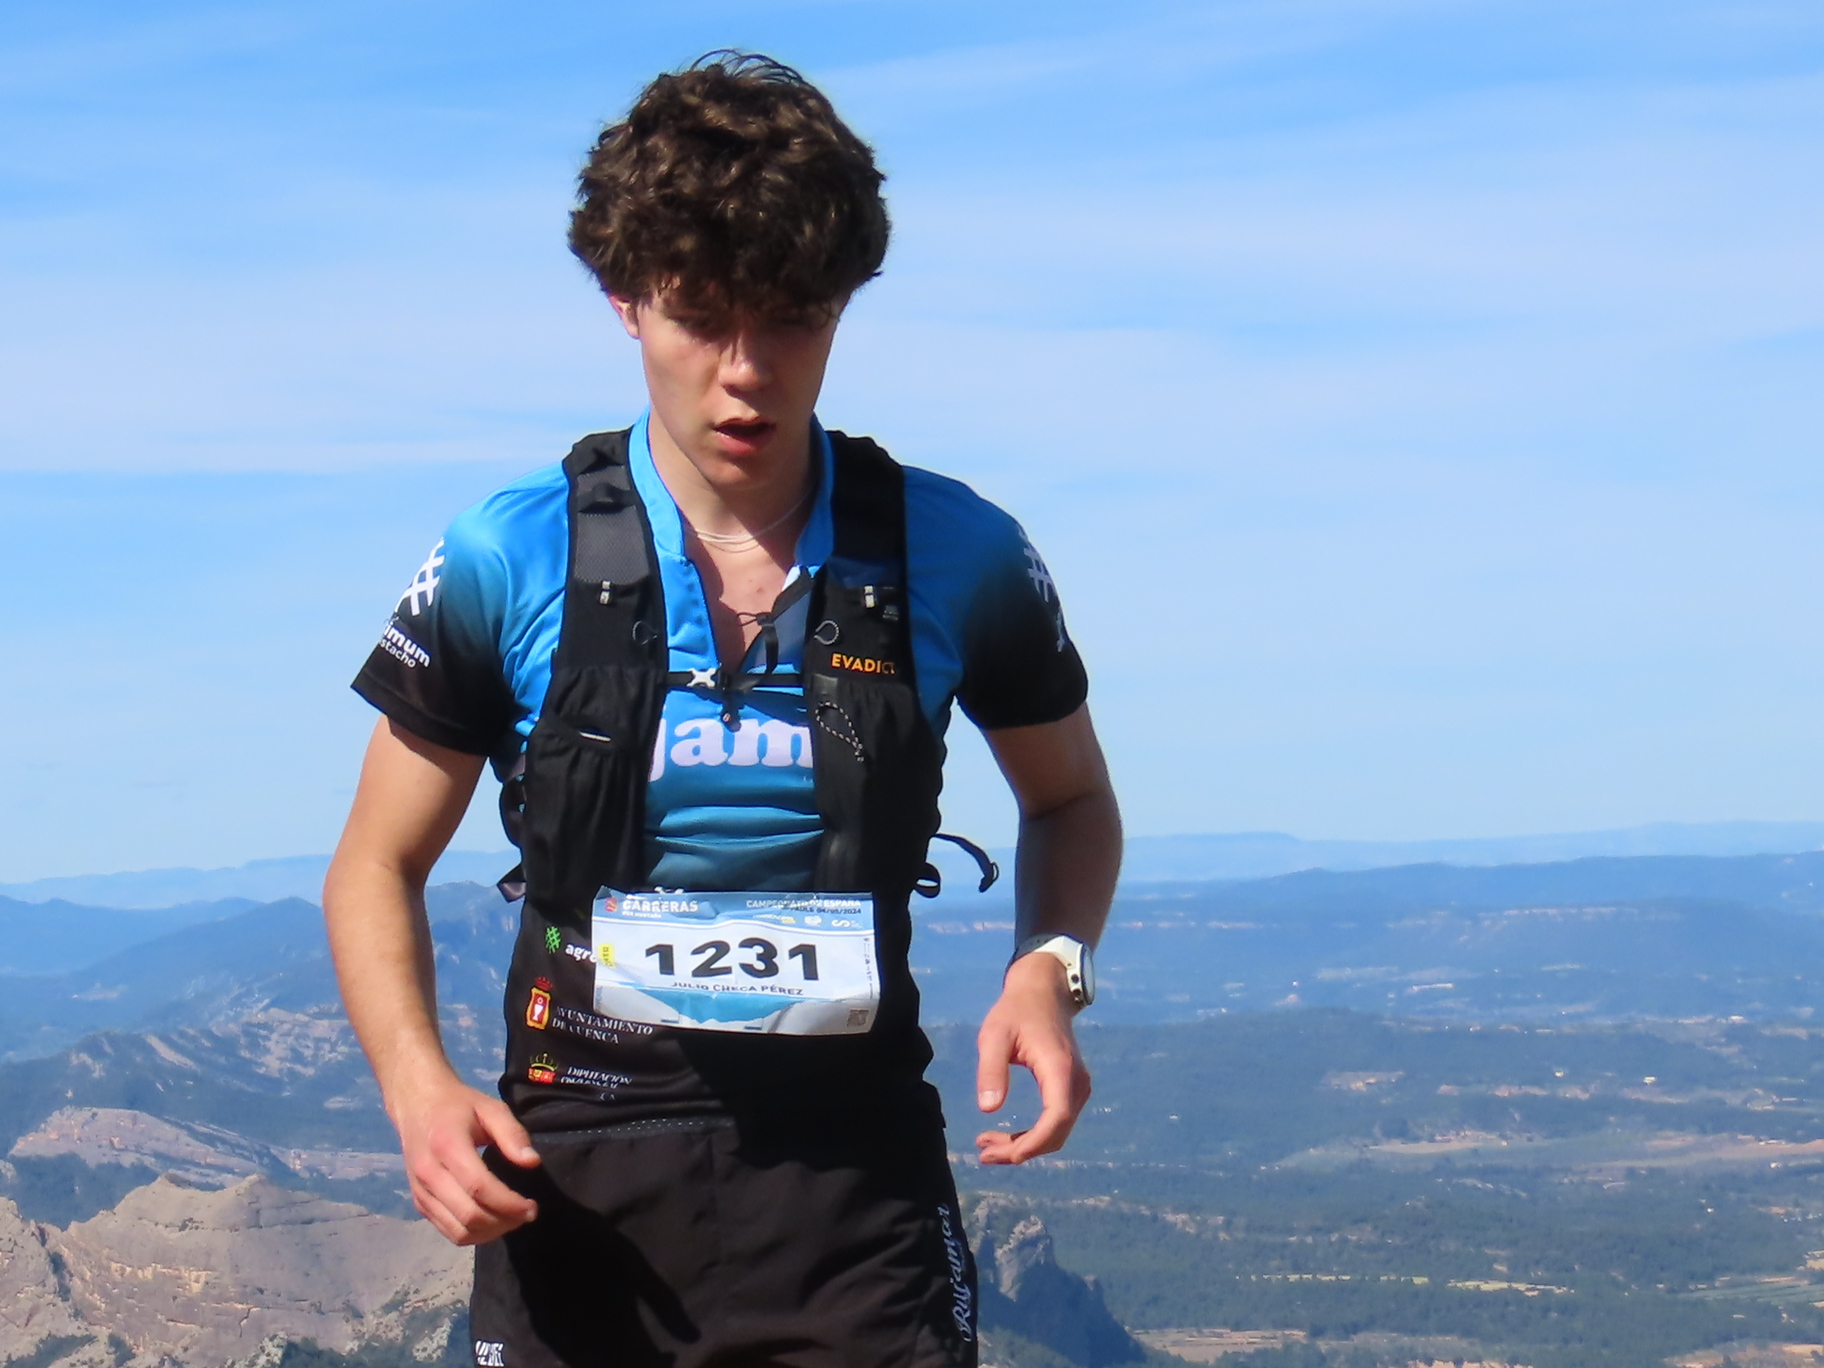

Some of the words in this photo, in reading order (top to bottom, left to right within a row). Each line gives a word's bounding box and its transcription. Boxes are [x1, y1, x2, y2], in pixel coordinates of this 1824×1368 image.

[621, 900, 699, 914] CARRERAS
[645, 936, 820, 981] 1231
[671, 981, 710, 991] JULIO
[712, 983, 758, 993] CHECA
[760, 984, 805, 996] PÉREZ
